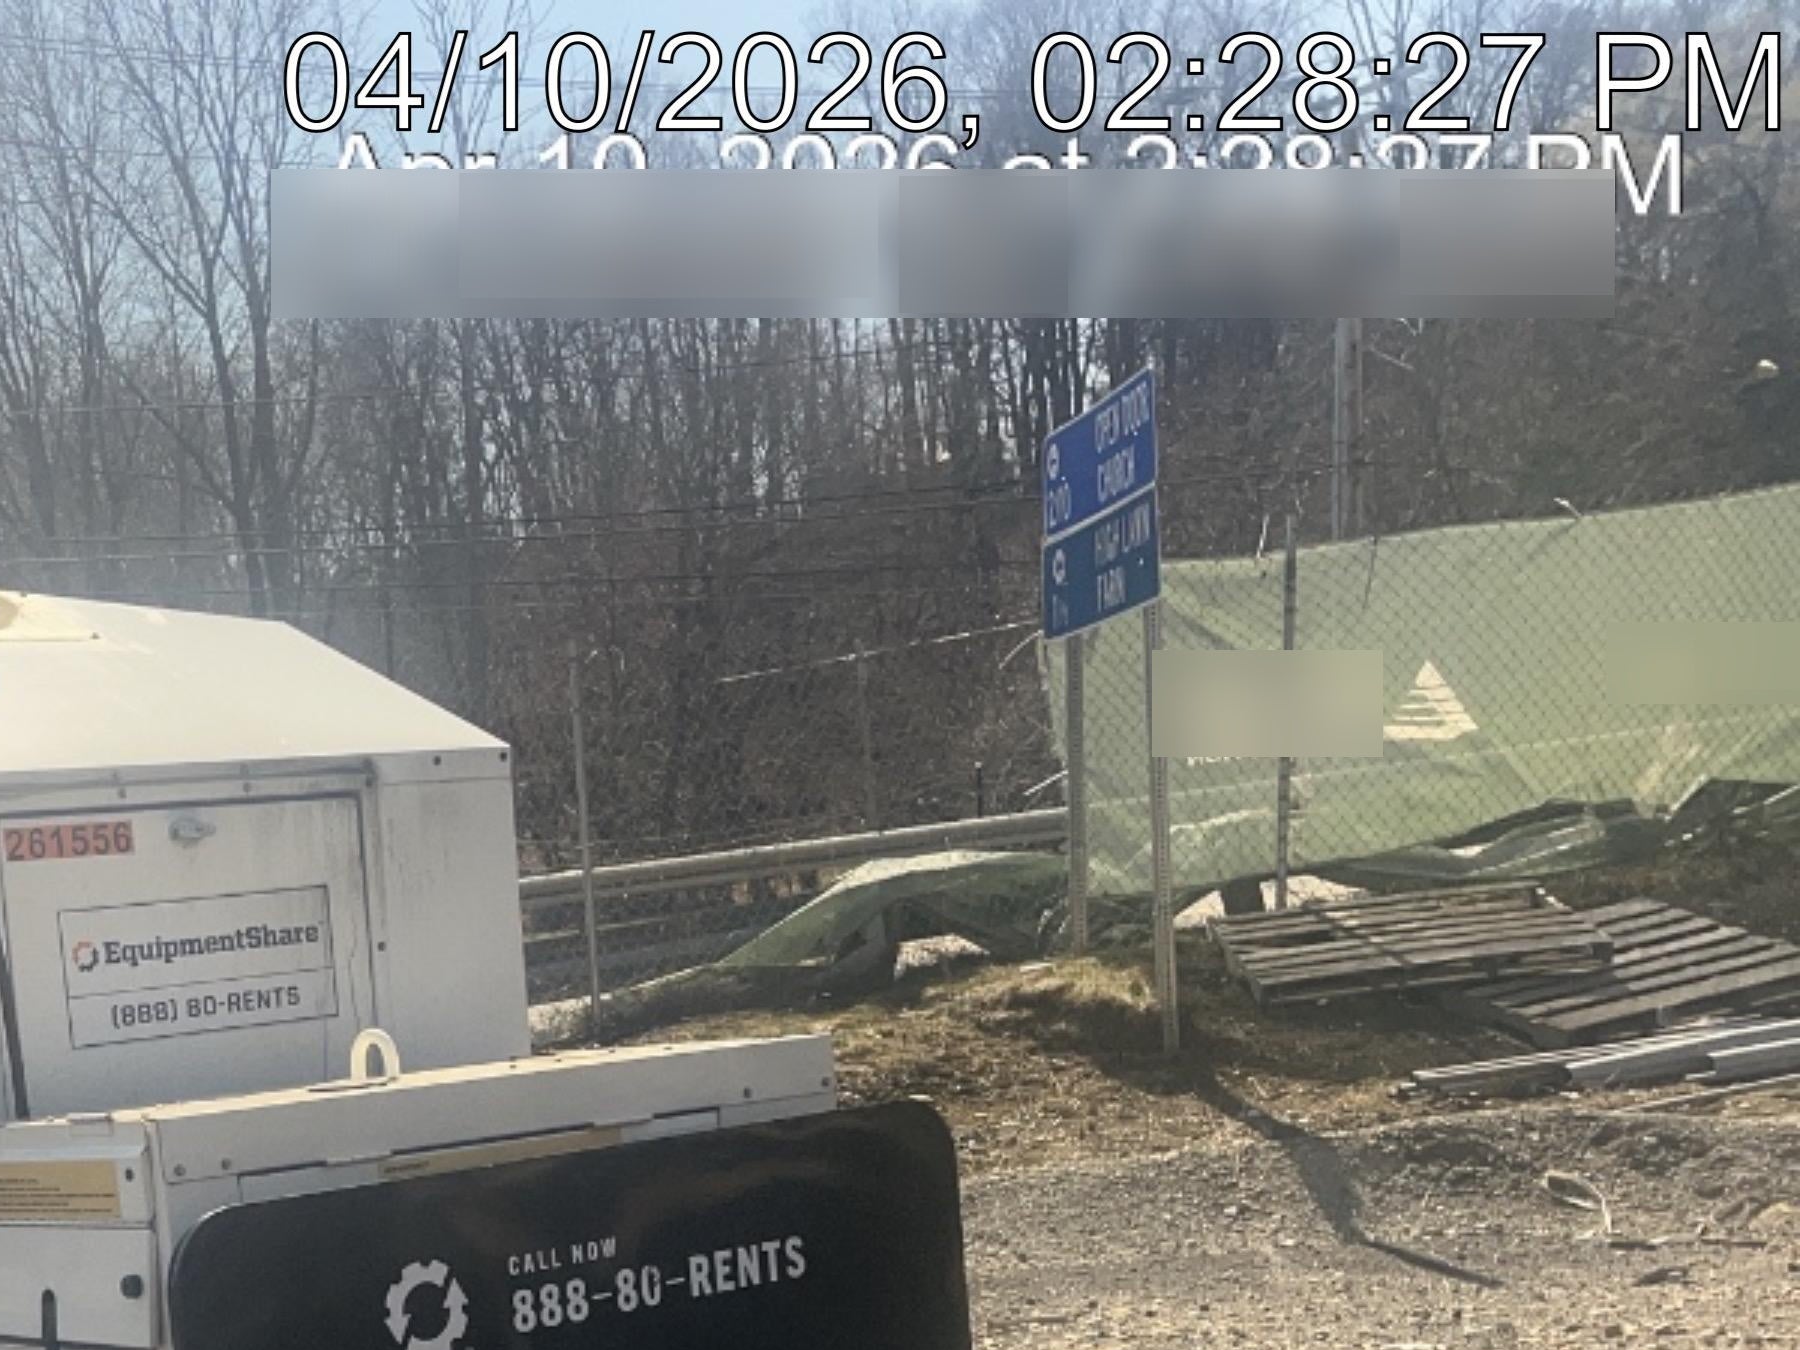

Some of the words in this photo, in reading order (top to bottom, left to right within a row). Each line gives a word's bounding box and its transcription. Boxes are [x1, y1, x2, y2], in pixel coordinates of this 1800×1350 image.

[5, 823, 133, 860] 261556
[103, 922, 320, 967] EquipmentShare
[111, 1000, 179, 1029] (888)
[187, 985, 302, 1018] 80-RENTS
[508, 1247, 560, 1276] CALL
[571, 1237, 618, 1265] NOW
[511, 1235, 807, 1334] 888-80-RENTS
